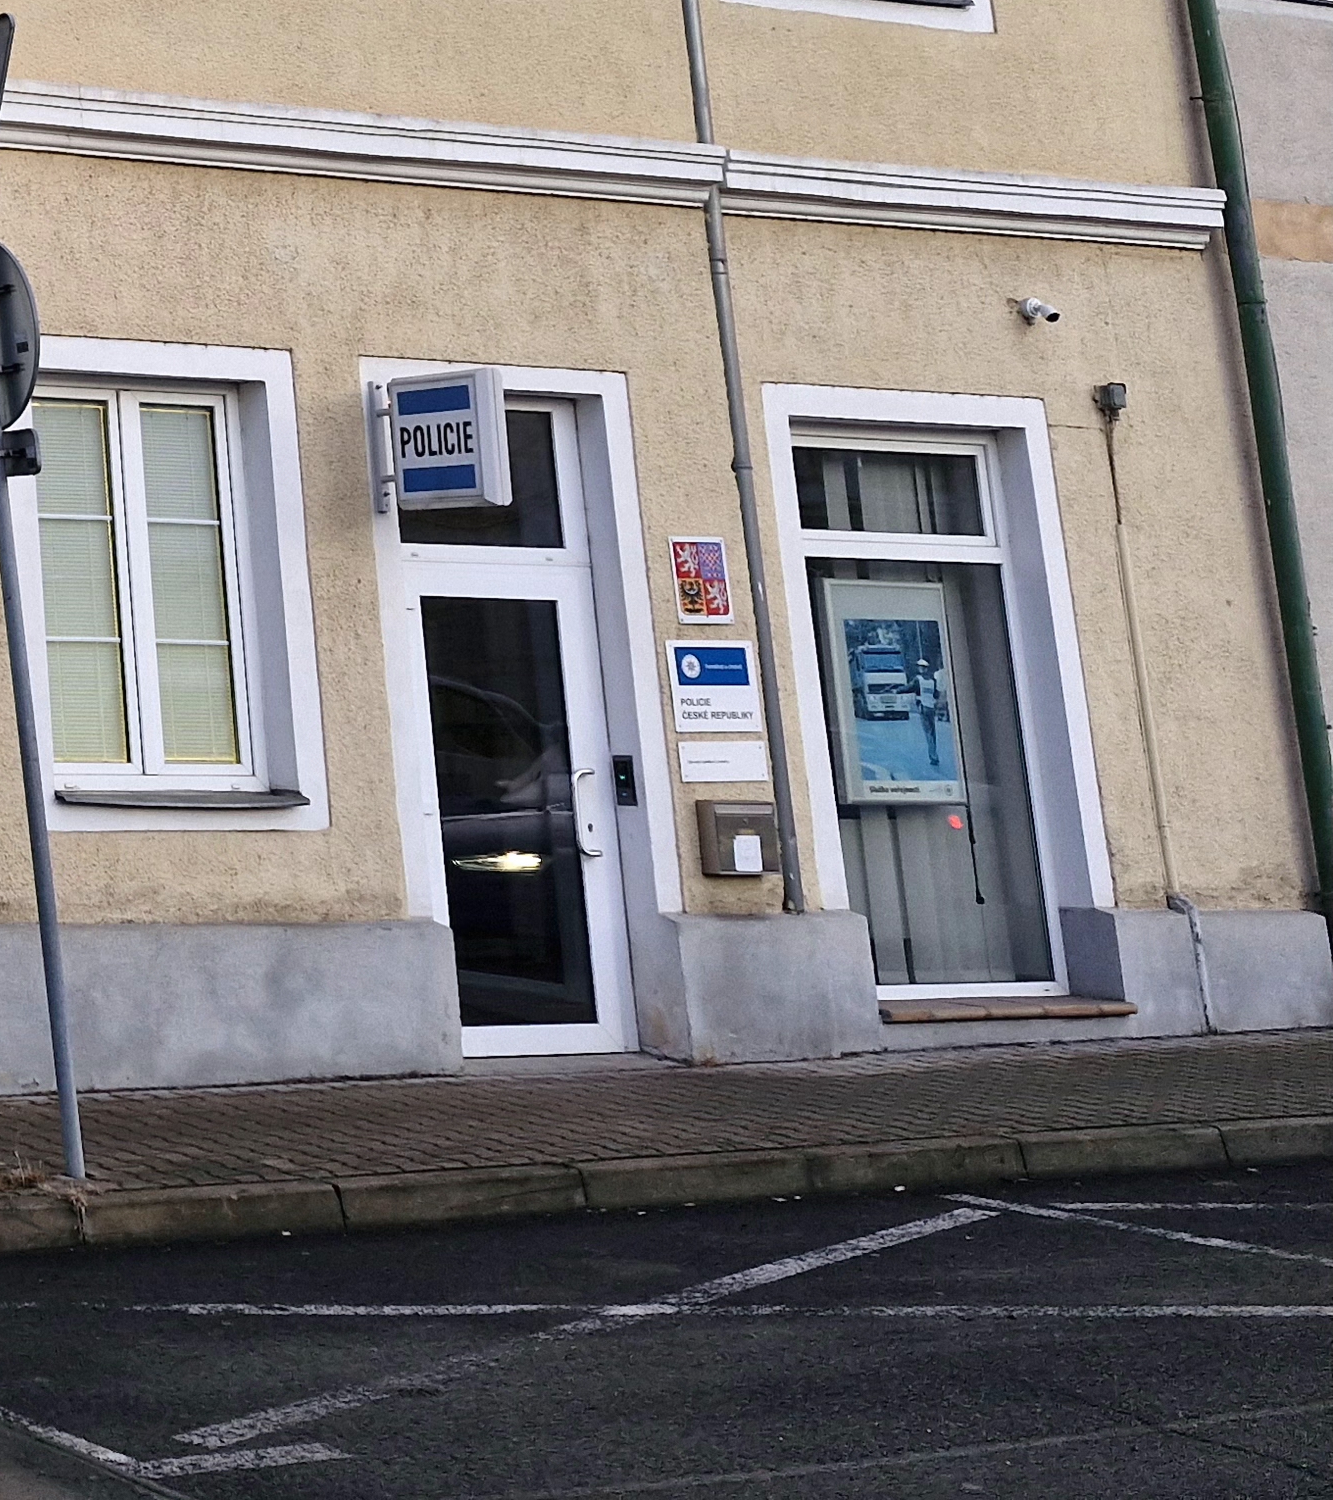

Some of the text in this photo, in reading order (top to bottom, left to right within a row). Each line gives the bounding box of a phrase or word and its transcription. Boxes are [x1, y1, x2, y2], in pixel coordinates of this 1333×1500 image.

[400, 421, 474, 459] POLICIE
[680, 698, 712, 706] POLICIE
[682, 709, 754, 720] ČESKÉ REPUBLIKY
